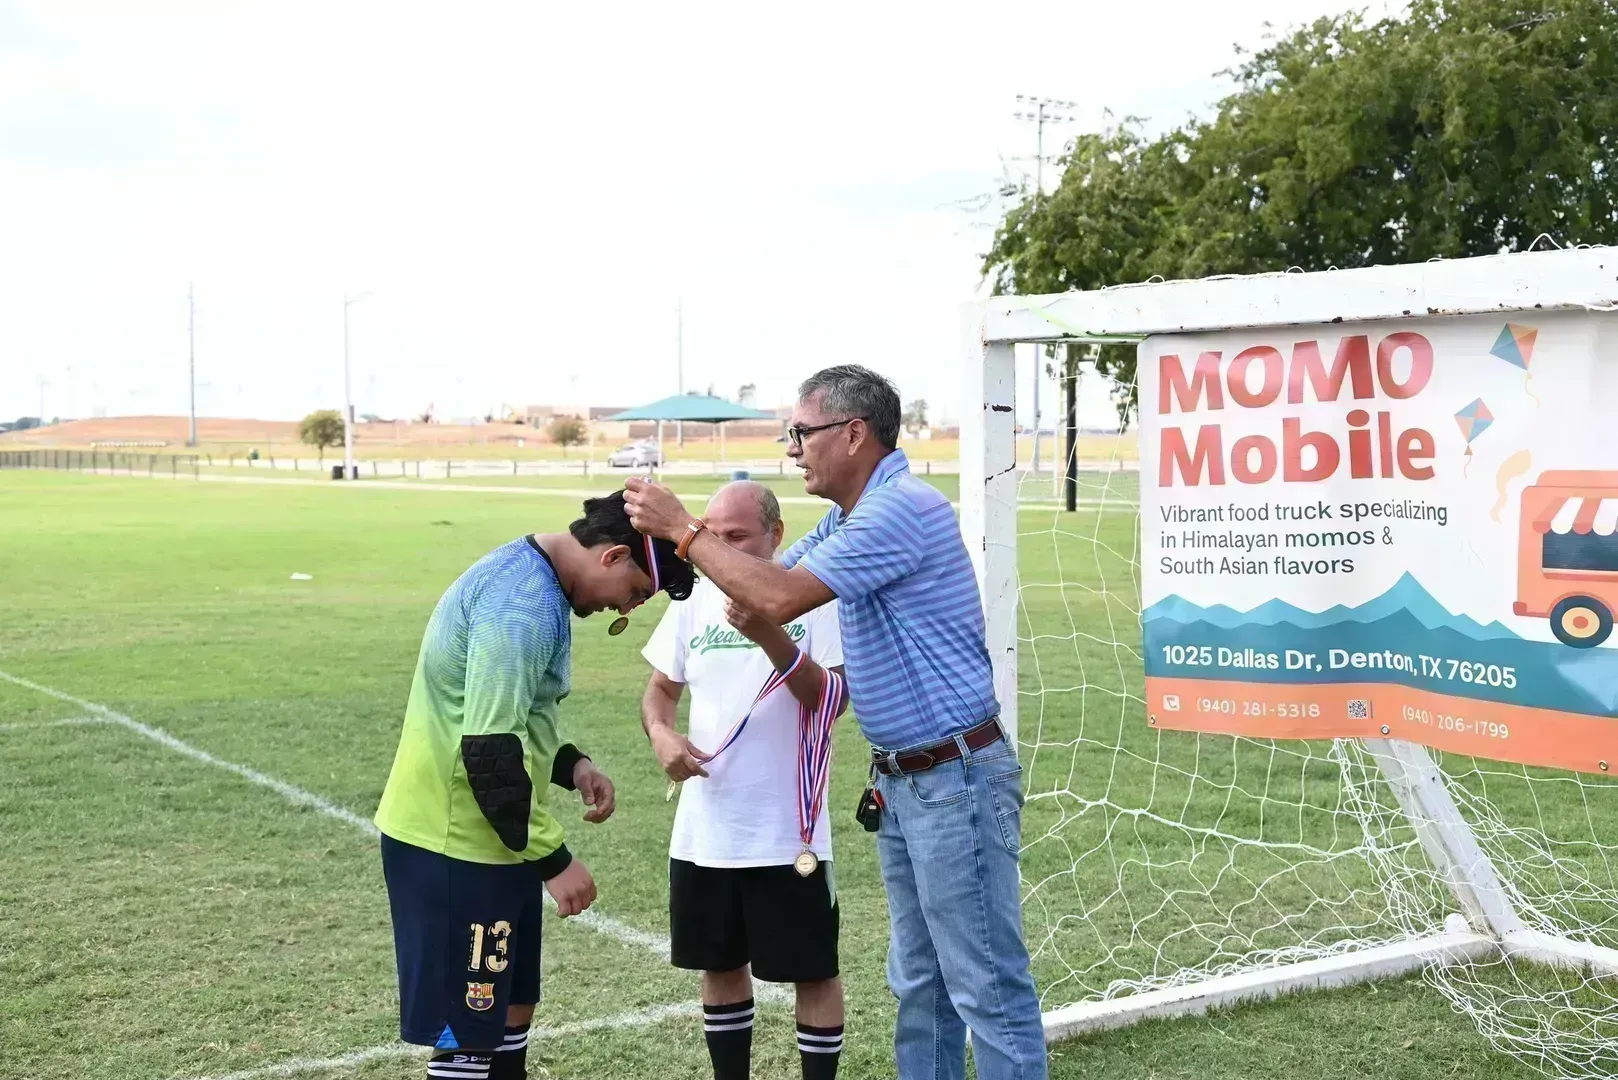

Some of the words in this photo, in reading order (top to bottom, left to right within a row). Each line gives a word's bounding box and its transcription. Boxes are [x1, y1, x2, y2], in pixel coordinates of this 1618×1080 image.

[1158, 331, 1434, 414] MOMO
[1158, 409, 1436, 488] Mobile
[1160, 505, 1224, 523] Vibrant
[1228, 503, 1269, 521] food
[1274, 500, 1333, 521] truck
[1339, 498, 1448, 526] specializing
[1161, 531, 1176, 548] in
[1182, 530, 1279, 552] Himalayan
[1285, 529, 1376, 548] momos
[1381, 526, 1394, 545] &
[1159, 556, 1215, 575] South
[1219, 556, 1269, 575] Asian
[1274, 556, 1355, 575] flavors
[690, 624, 746, 649] Mean
[1162, 645, 1213, 666] 1025
[1217, 647, 1280, 670] Dallas
[1285, 649, 1323, 672] Dr,
[1328, 648, 1418, 677] Denton,
[1418, 654, 1443, 679] TX
[1446, 659, 1517, 689] 76205
[1196, 697, 1236, 715] (940)
[1242, 701, 1321, 718] 281-5318
[1402, 704, 1433, 727] (940)
[1437, 714, 1509, 739] 206-1799
[467, 920, 512, 973] 13
